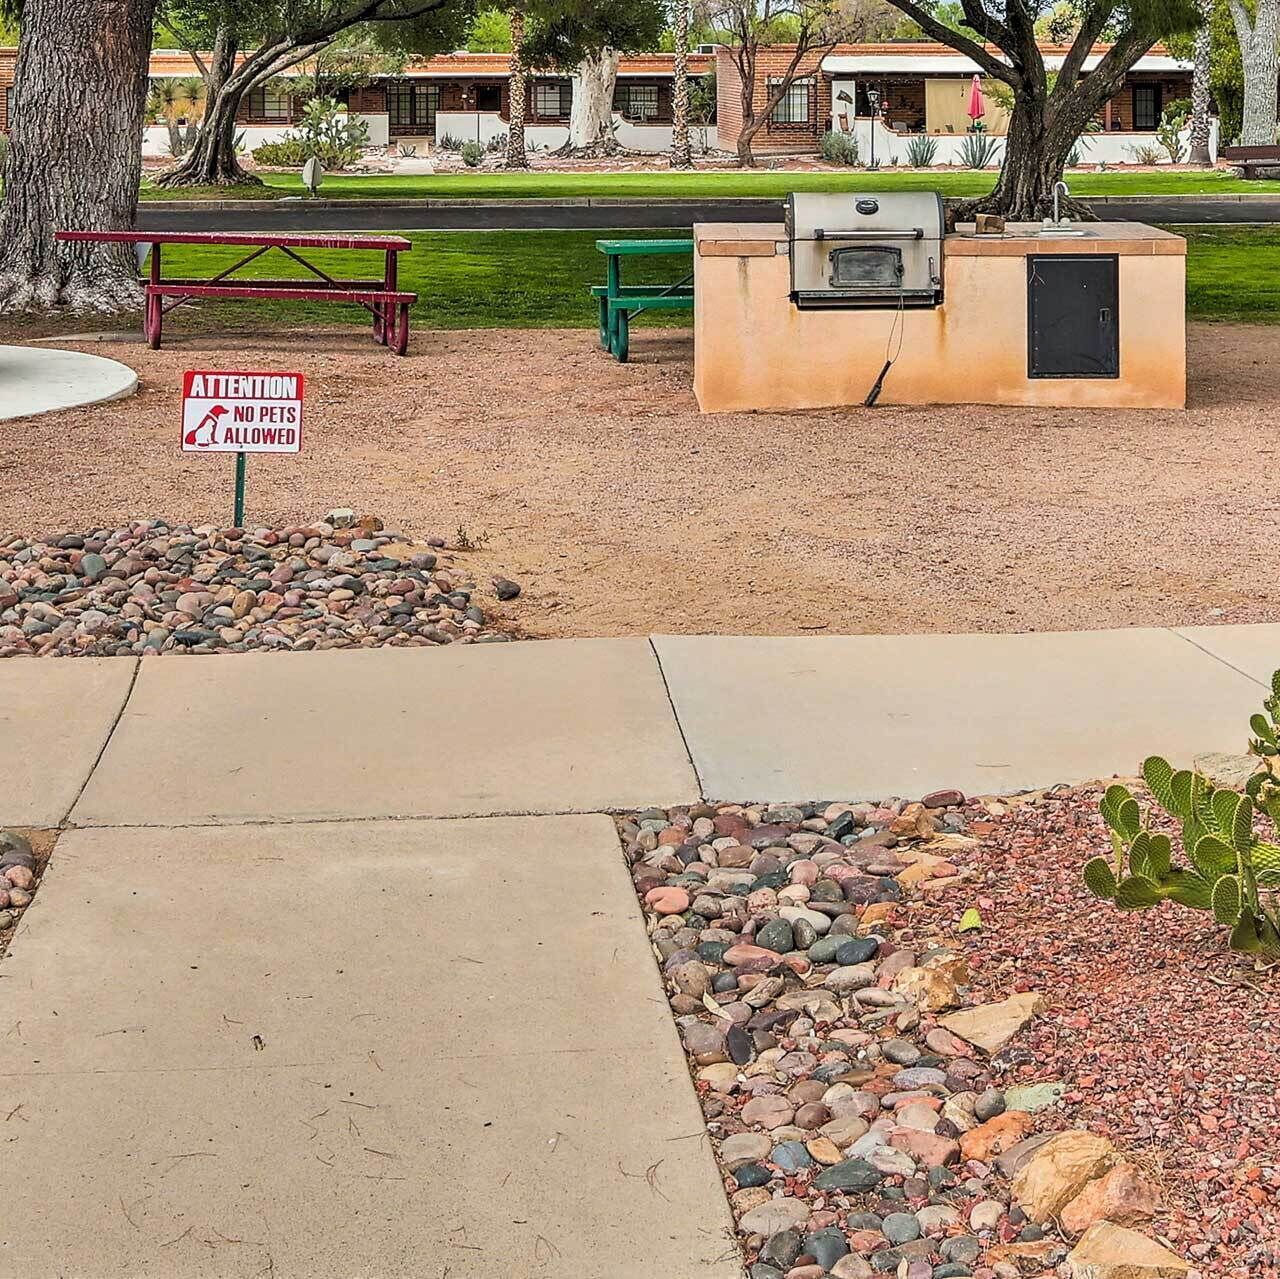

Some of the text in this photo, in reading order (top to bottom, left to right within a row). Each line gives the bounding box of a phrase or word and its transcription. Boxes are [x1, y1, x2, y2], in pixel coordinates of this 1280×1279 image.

[190, 374, 297, 399] ATTENTION
[233, 405, 296, 423] NO PETS
[223, 427, 296, 445] ALLOWED
